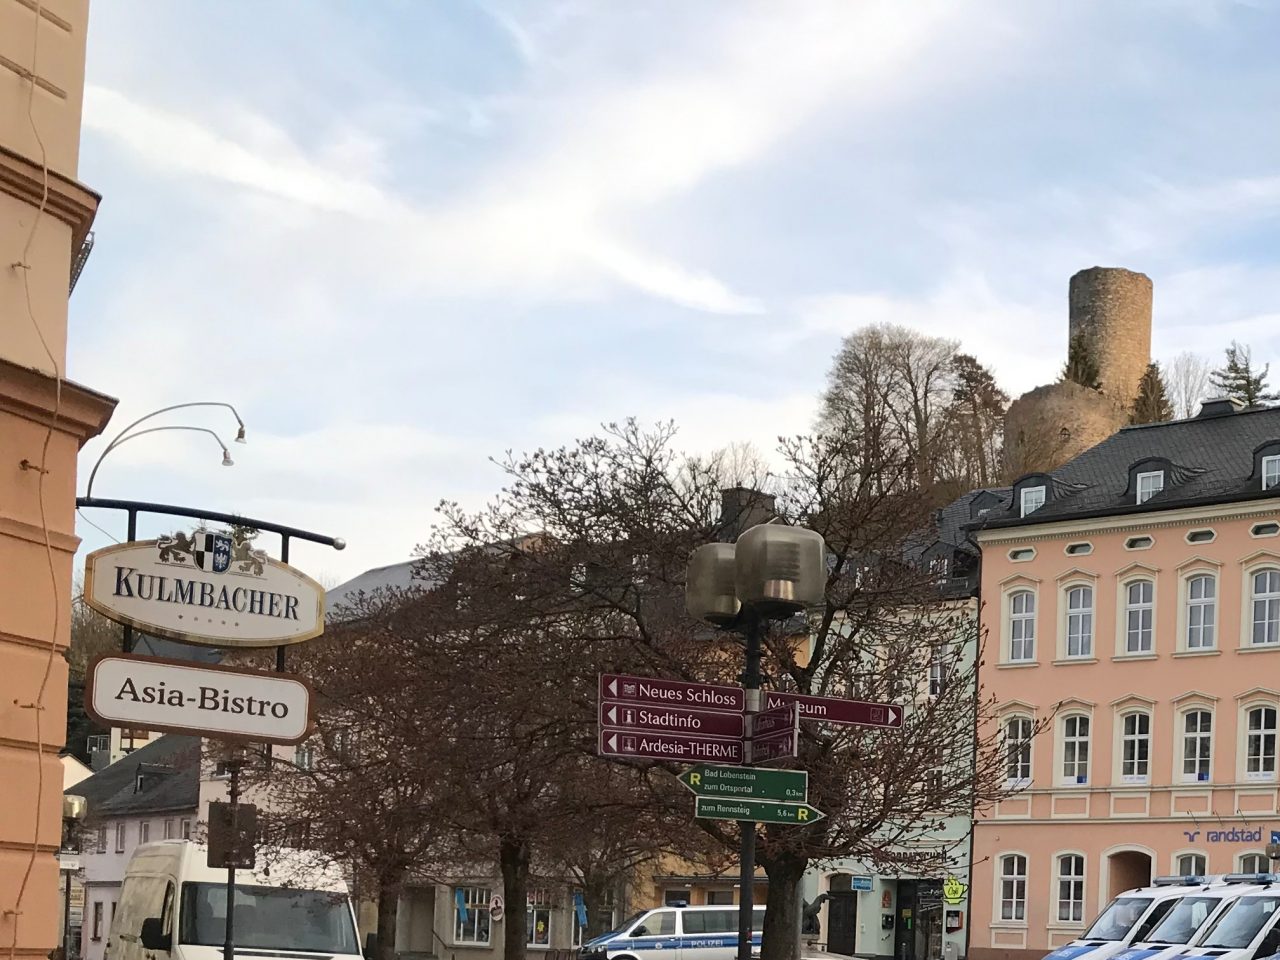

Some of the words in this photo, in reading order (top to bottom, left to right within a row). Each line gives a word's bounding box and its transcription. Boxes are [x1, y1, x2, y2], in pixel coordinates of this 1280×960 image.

[113, 566, 300, 620] KULMBACHER
[115, 678, 289, 719] Asia-Bistro
[639, 680, 683, 700] Neues
[686, 686, 737, 706] Schloss
[767, 697, 827, 715] Meum
[639, 710, 701, 729] Stadtinfo
[690, 773, 701, 785] R
[704, 769, 718, 778] Bad
[719, 770, 756, 781] Lobenstein
[719, 783, 753, 793] Ortsportal
[717, 804, 750, 815] Rennsteig
[798, 808, 808, 821] R
[1206, 826, 1262, 842] randstad
[691, 940, 723, 948] POLIZEI
